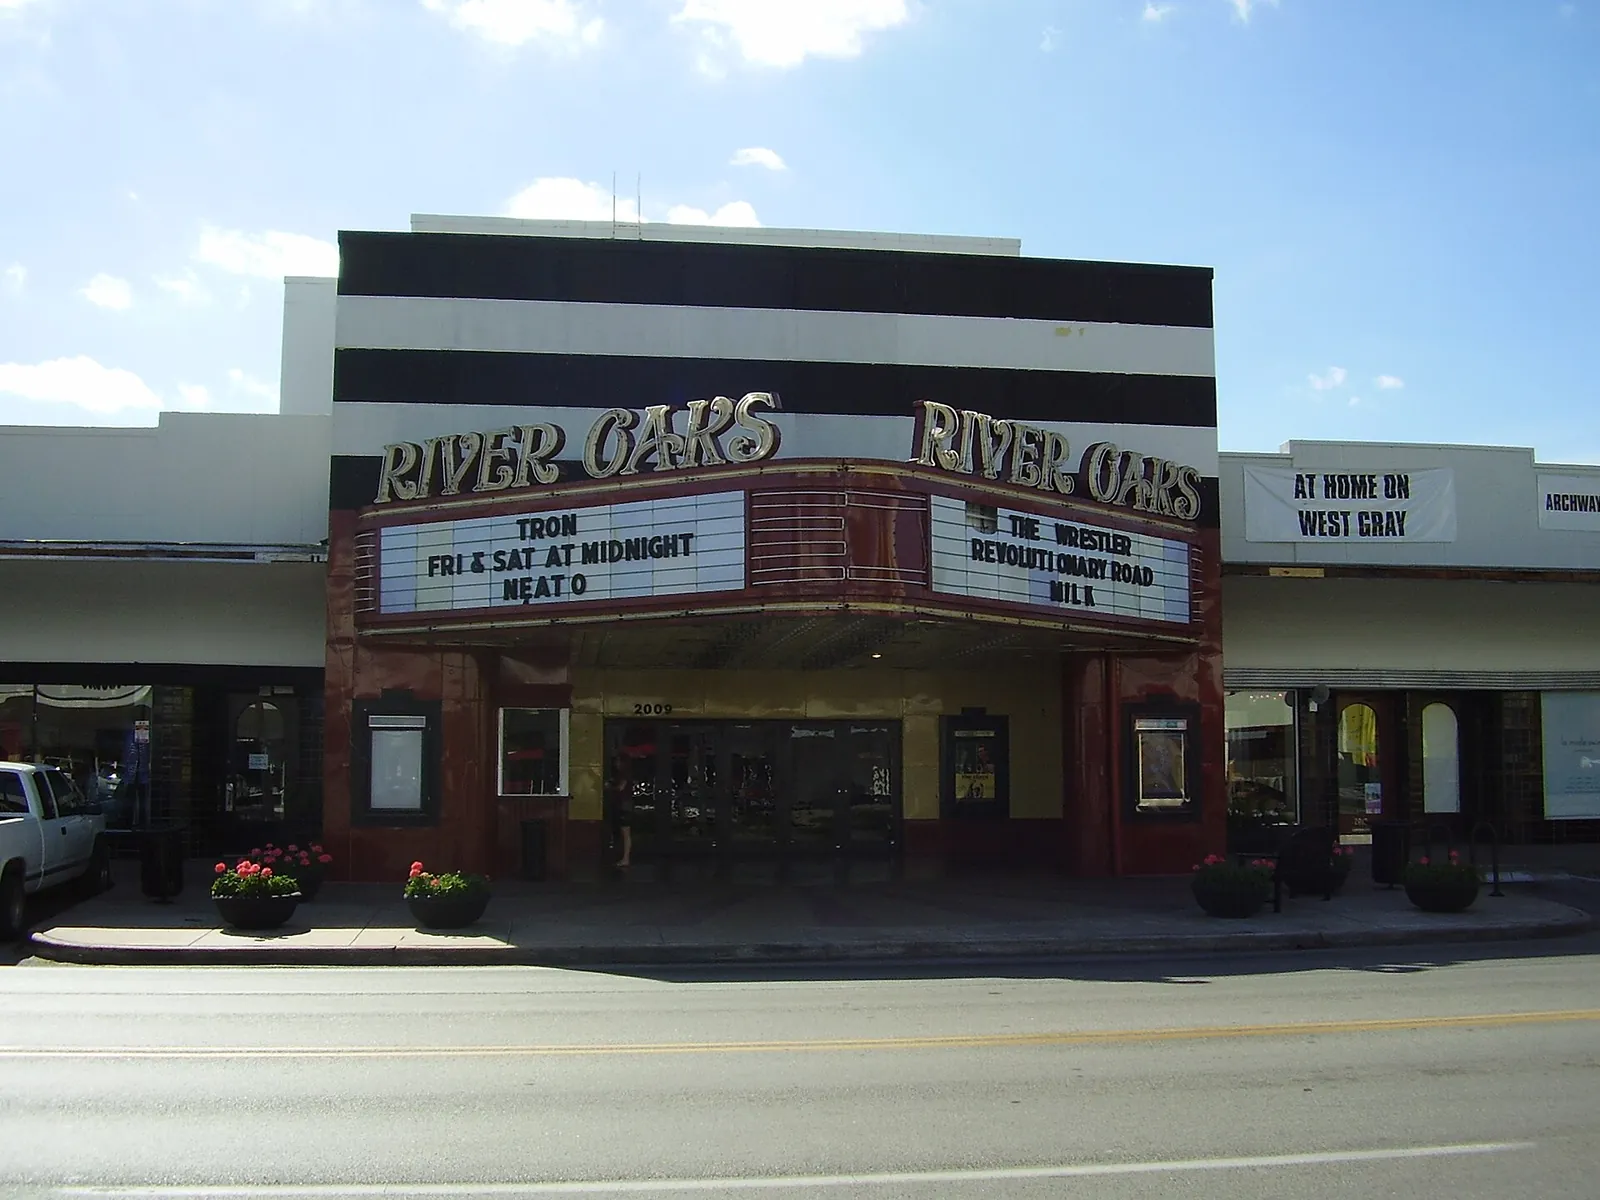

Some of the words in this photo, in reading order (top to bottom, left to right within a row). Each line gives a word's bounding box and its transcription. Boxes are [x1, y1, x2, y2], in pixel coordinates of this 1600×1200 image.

[374, 422, 565, 504] RIVER
[582, 391, 781, 479] OAKS
[914, 400, 1075, 495] RIVER
[1086, 441, 1201, 521] OAKS
[1294, 473, 1316, 499] AT
[1324, 474, 1378, 499] HOME
[1384, 474, 1410, 500] ON
[516, 513, 577, 541] TRON
[1009, 515, 1041, 541] THE
[1054, 523, 1133, 557] WRESTLER
[1298, 510, 1351, 537] WEST
[1358, 510, 1408, 537] GRAY
[428, 553, 462, 578] FRI
[470, 551, 485, 574] &
[493, 547, 535, 572] SAT
[545, 543, 575, 568] AT
[581, 532, 694, 565] MIDNIGHT
[971, 537, 1108, 581] REVOLUTIONARY
[1111, 560, 1154, 588] ROAD
[1050, 580, 1096, 607] MILK
[634, 703, 673, 715] 2009
